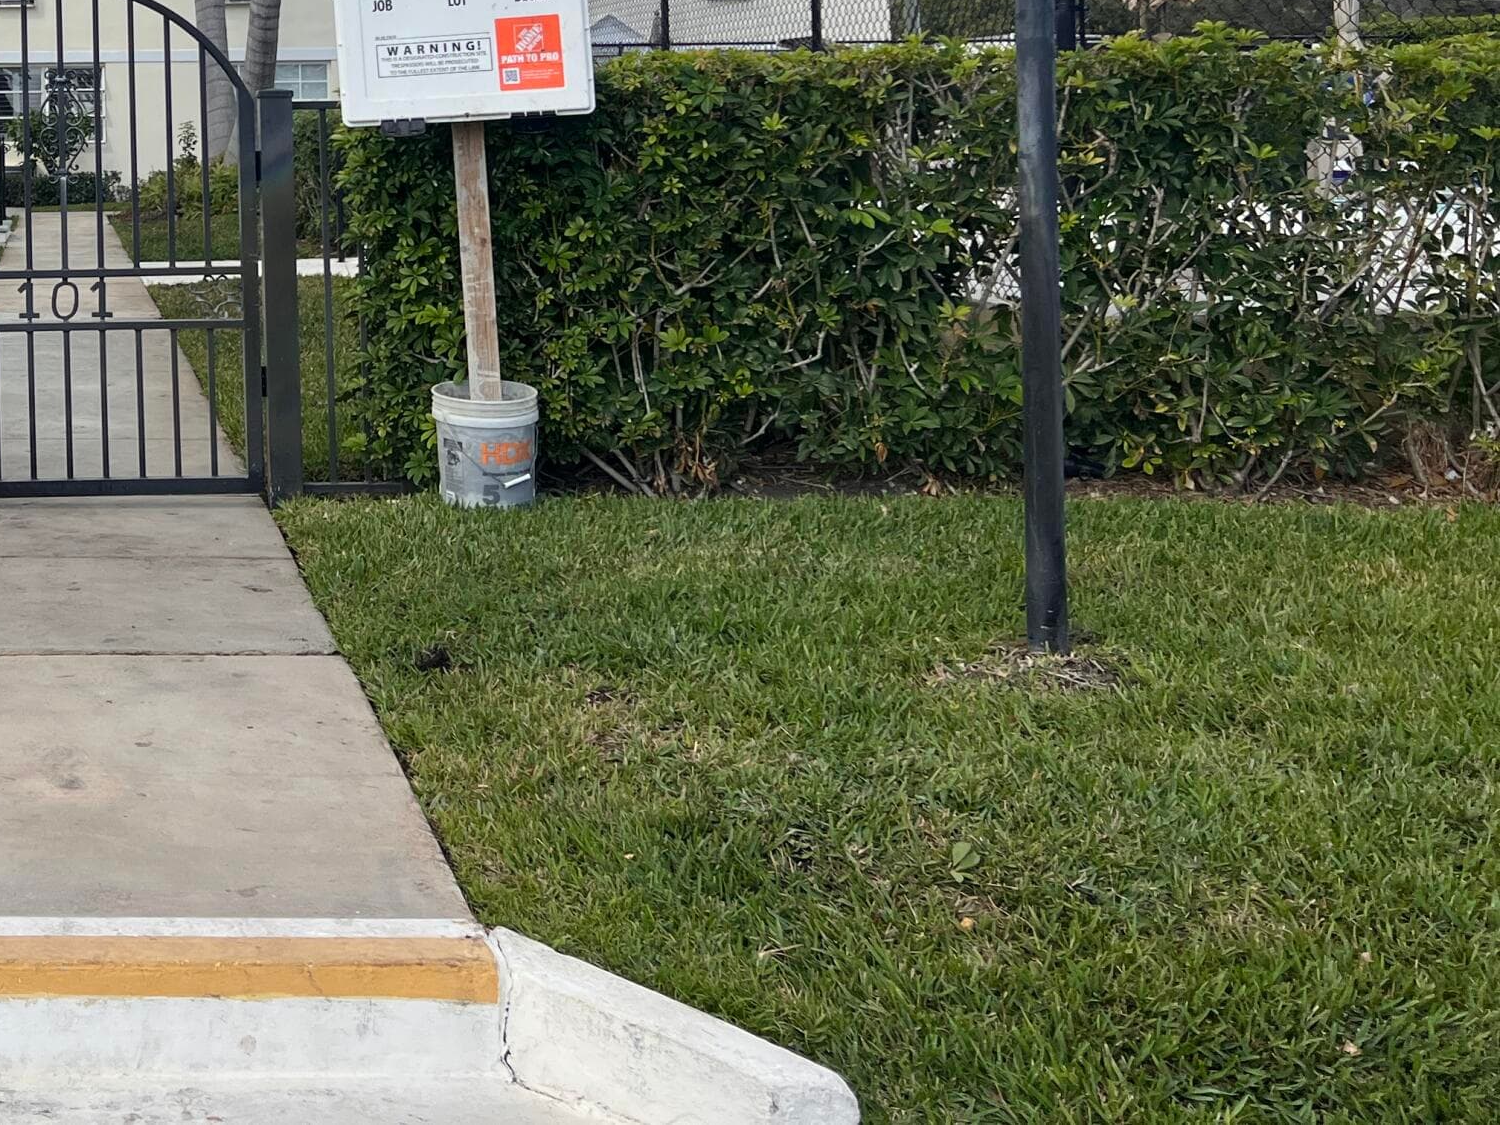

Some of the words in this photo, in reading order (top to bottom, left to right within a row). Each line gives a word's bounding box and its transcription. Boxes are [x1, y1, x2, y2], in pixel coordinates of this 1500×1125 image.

[372, 0, 394, 13] JOB
[386, 40, 482, 57] WARNING!
[500, 54, 525, 65] PATH
[526, 53, 538, 63] TO
[540, 51, 560, 62] PRO
[17, 281, 113, 321] 101
[482, 484, 501, 504] 5
